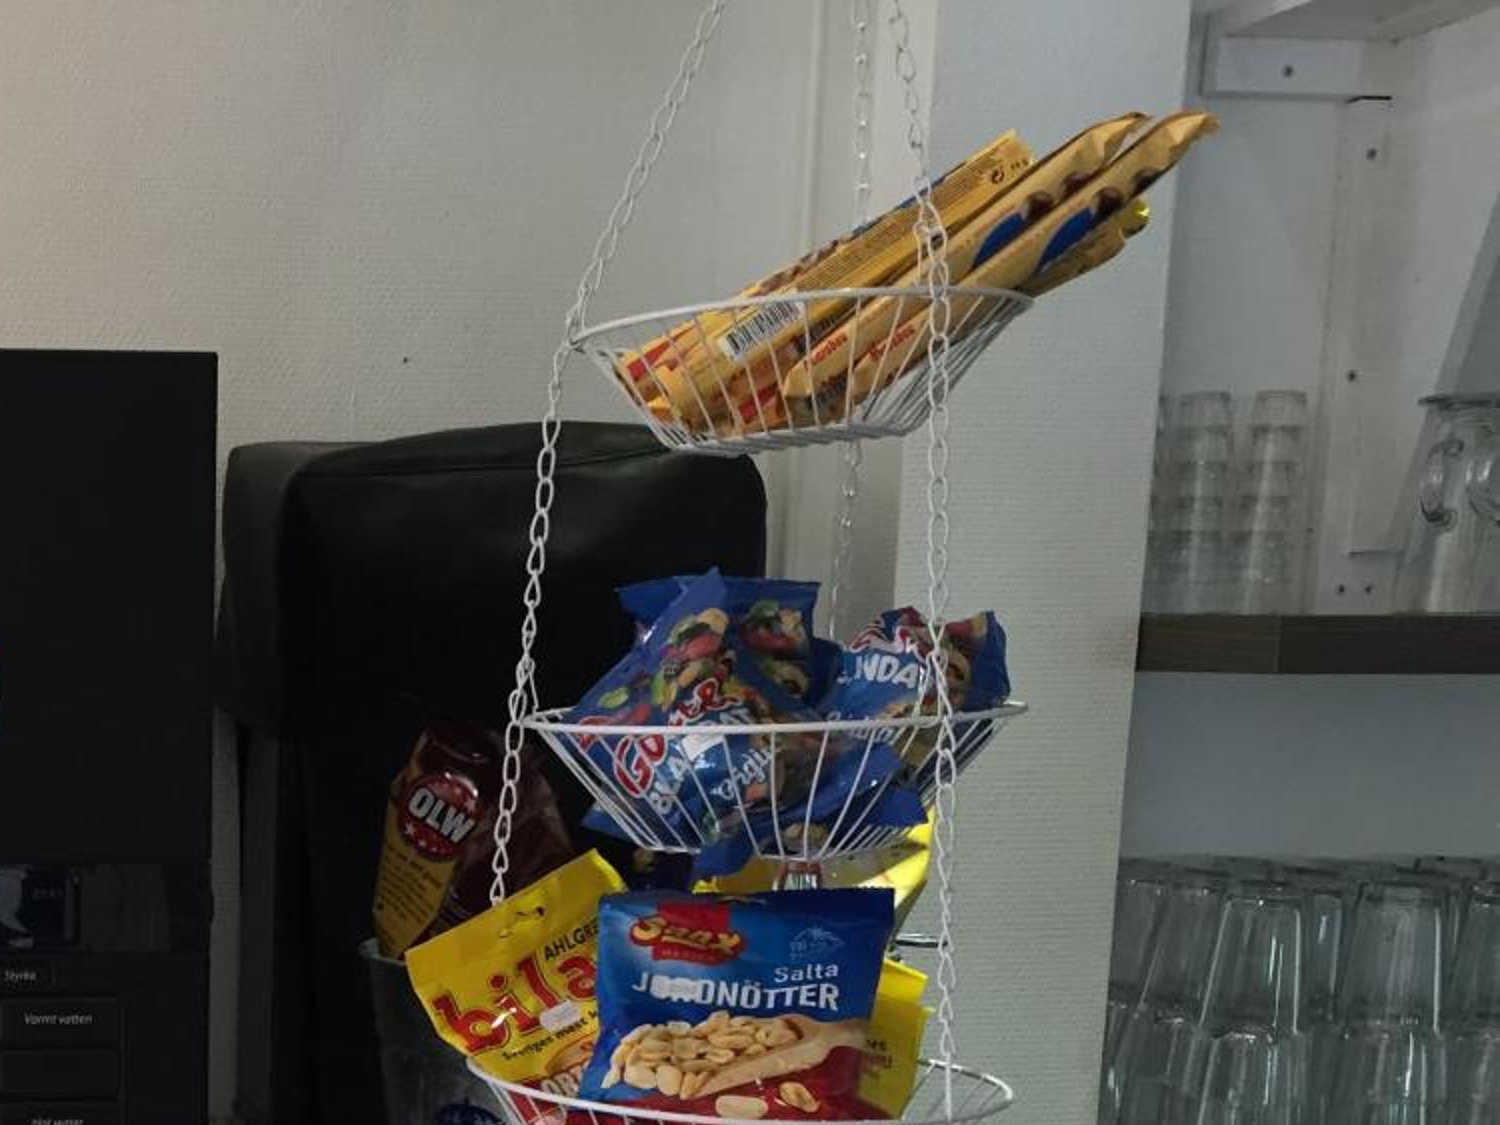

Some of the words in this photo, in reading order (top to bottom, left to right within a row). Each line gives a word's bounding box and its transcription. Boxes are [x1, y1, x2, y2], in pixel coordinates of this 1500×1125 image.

[407, 786, 476, 844] OLW
[631, 972, 840, 1011] JDNÖTTER
[774, 962, 839, 984] Salta
